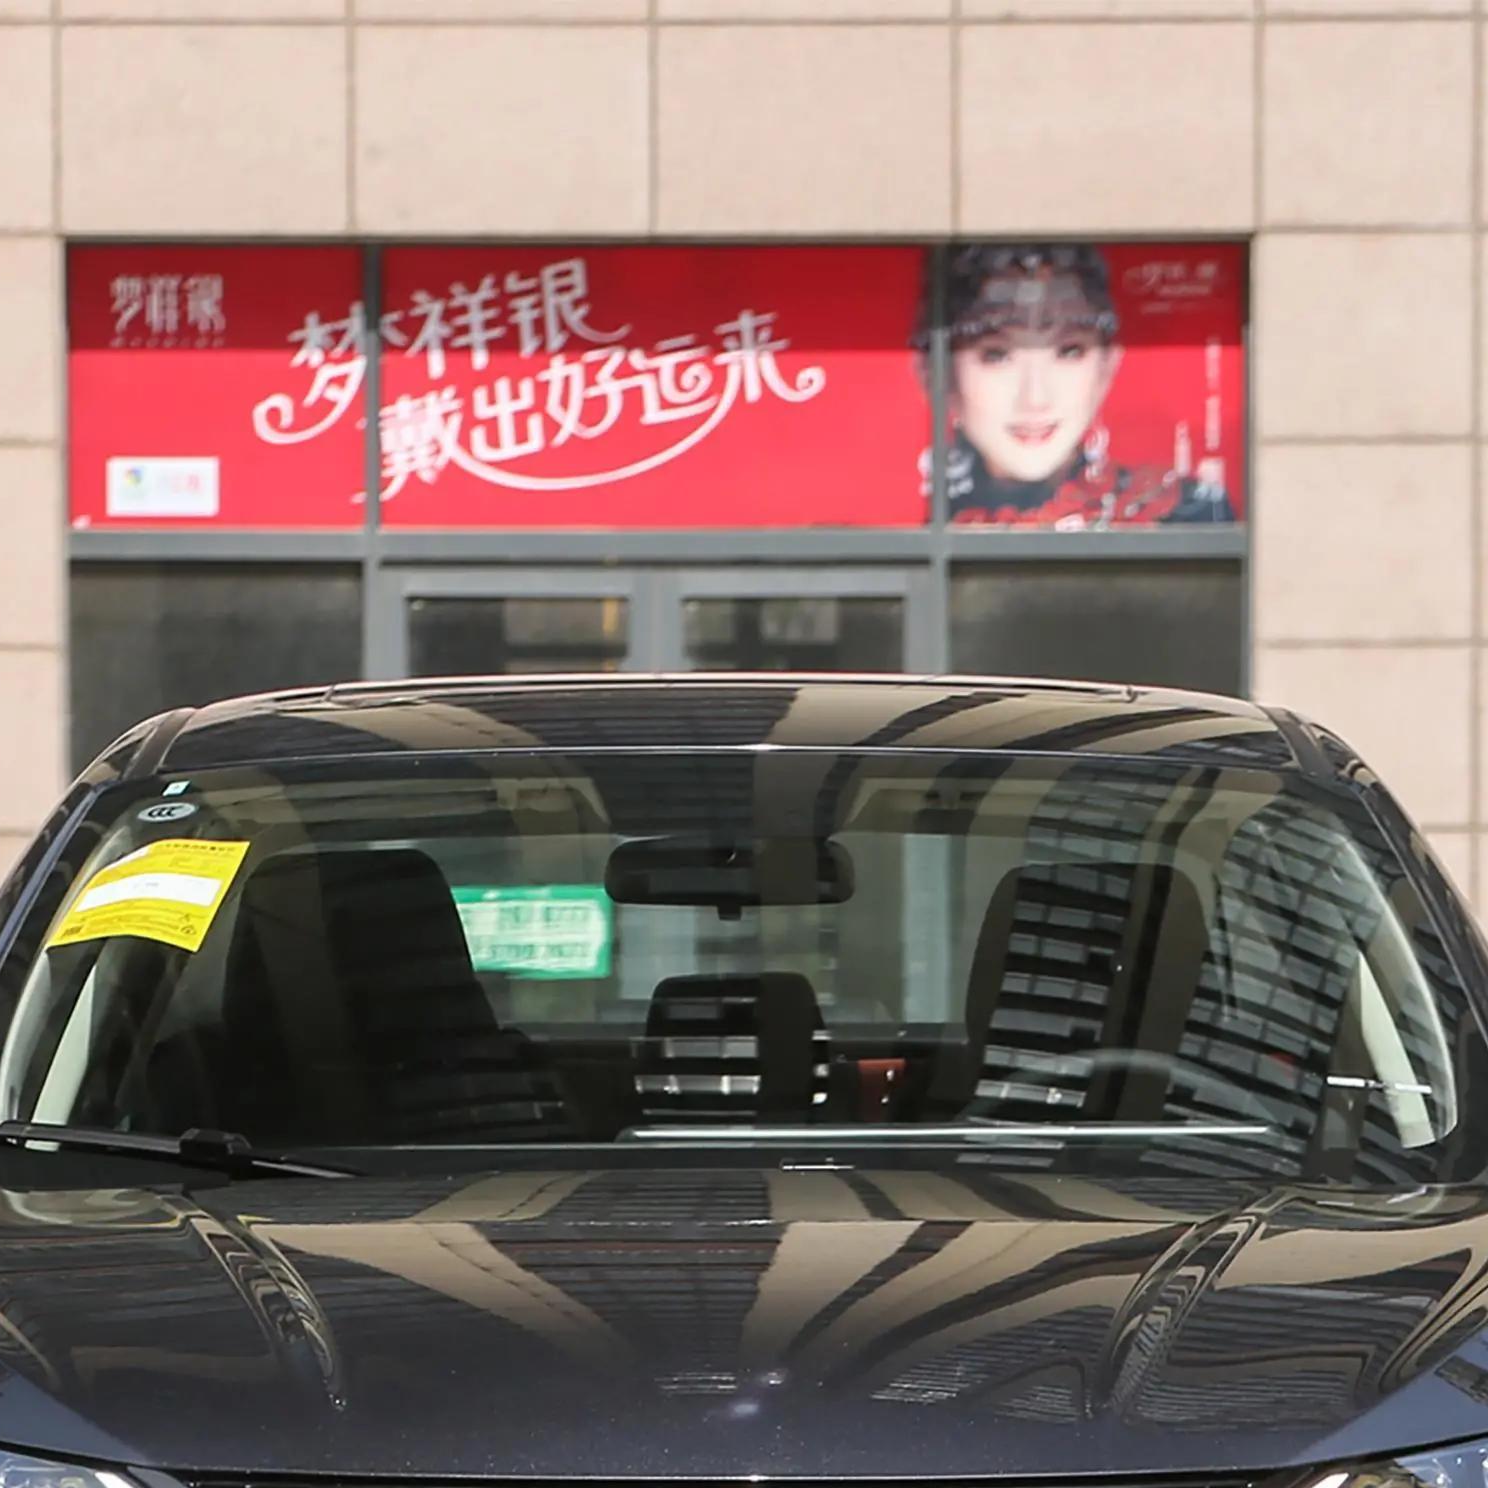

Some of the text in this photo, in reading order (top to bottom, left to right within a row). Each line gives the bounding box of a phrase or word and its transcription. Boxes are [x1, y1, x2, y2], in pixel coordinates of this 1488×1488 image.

[253, 257, 632, 445] 梦祥银
[372, 308, 832, 502] 戴出好运来
